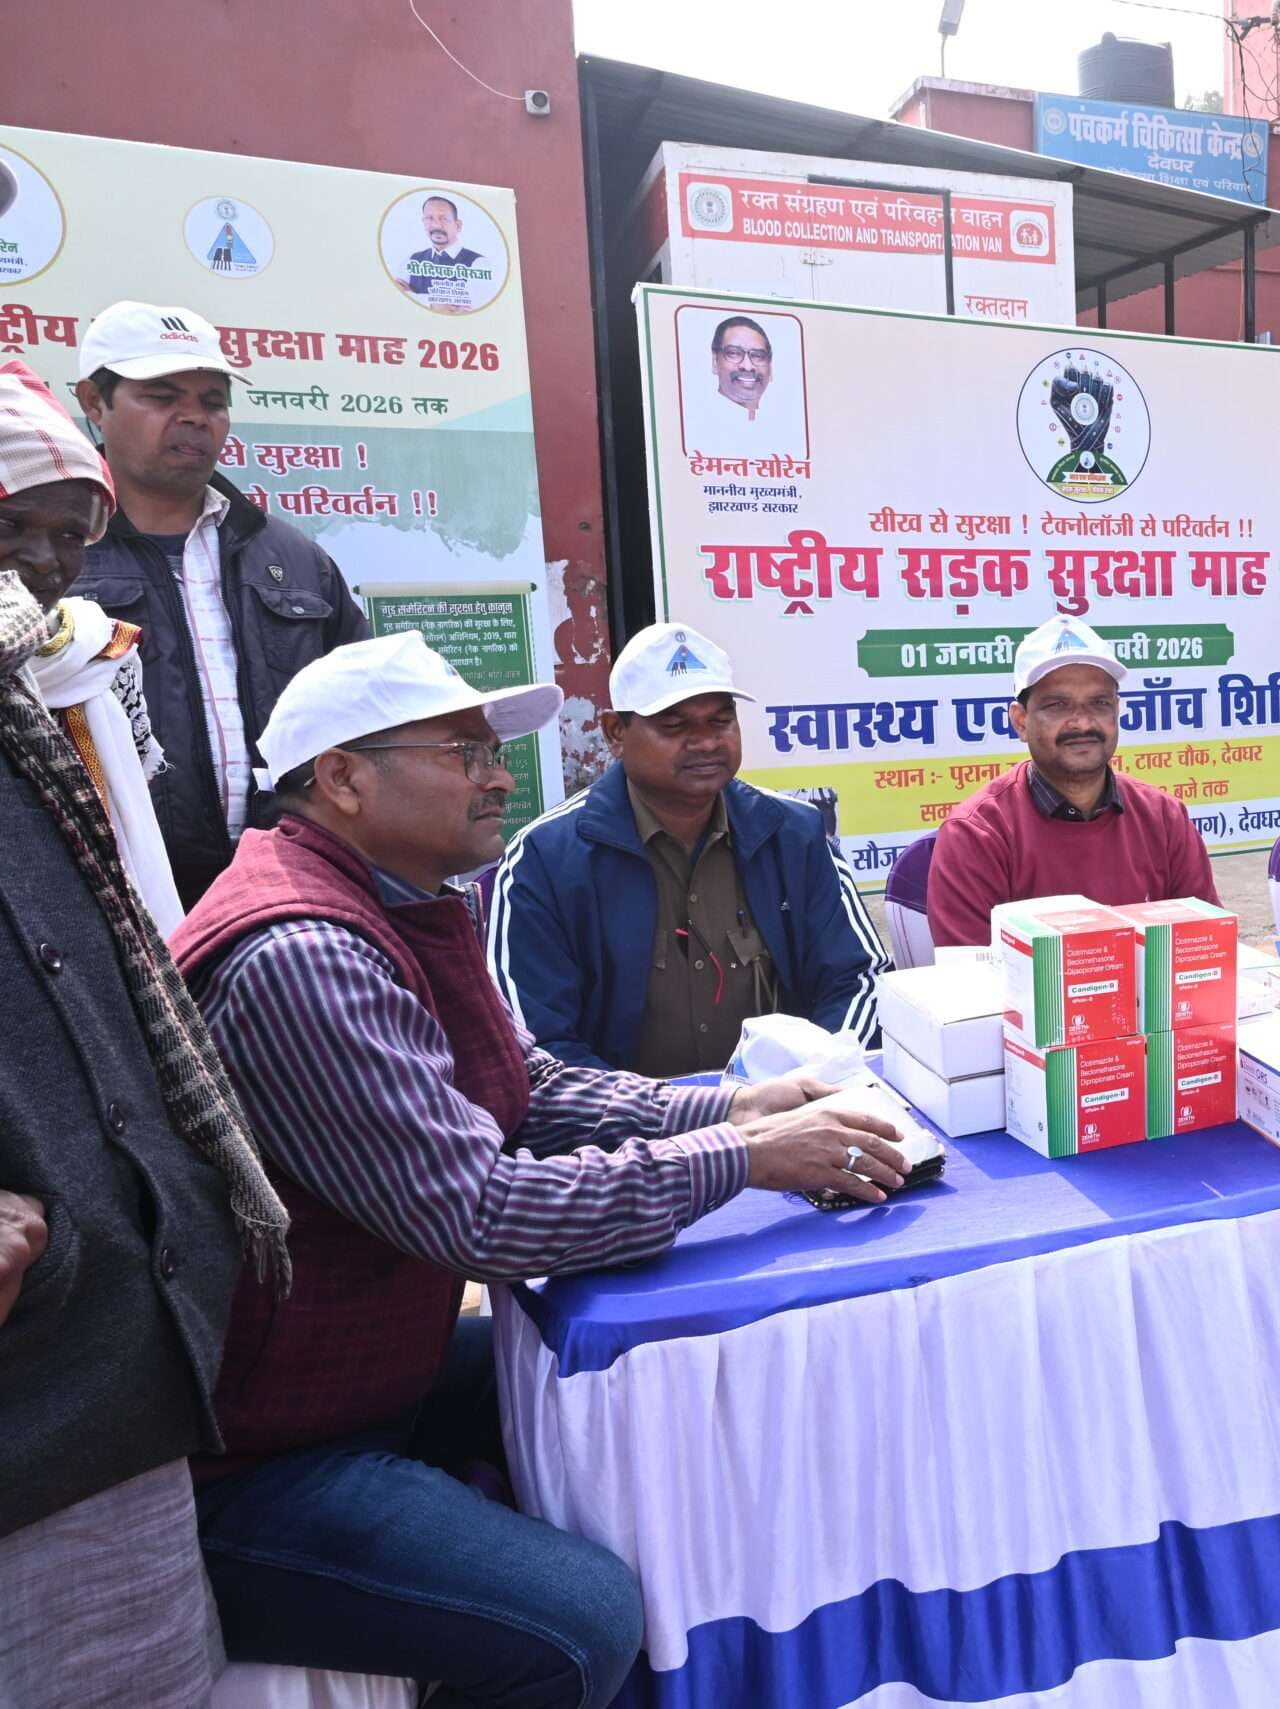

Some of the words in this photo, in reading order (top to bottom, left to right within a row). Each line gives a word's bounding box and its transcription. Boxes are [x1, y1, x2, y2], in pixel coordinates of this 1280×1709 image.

[1068, 104, 1128, 147] पंचकर्म
[1132, 112, 1203, 156] चिकित्सा
[1206, 121, 1244, 161] केन्द्र
[1147, 152, 1196, 174] देवघर
[740, 188, 779, 211] रक्त
[784, 188, 845, 219] संग्रहण
[849, 195, 879, 221] एवं
[961, 208, 1004, 230] वाहन
[743, 219, 782, 239] BLOOD
[784, 223, 854, 244] COLLECTION
[855, 228, 878, 245] AND
[982, 237, 1002, 253] VAN
[964, 294, 1029, 319] रक्तदान
[160, 331, 199, 343] adidas
[338, 333, 408, 364] माह
[417, 337, 500, 372] 2026
[247, 386, 330, 412] जनवरी
[341, 394, 403, 415] 2026
[413, 393, 449, 416] तक
[256, 440, 342, 476] सुरक्षा
[357, 442, 367, 468] !
[688, 450, 749, 477] हेमन्त
[756, 453, 812, 480] सोरेन
[279, 488, 398, 517] परिवर्तन
[413, 493, 438, 516] !!
[703, 484, 746, 498] माननीय
[762, 502, 799, 514] सरकार
[869, 507, 922, 535] सीख
[929, 508, 948, 534] से
[955, 514, 1012, 541] सुरक्षा
[1022, 514, 1028, 535] !
[1041, 510, 1134, 537] टेक्नोलॉजी
[1140, 513, 1157, 537] से
[1163, 514, 1231, 538] परिवर्तन
[1239, 518, 1253, 538] !!
[699, 529, 884, 616] राष्ट्रीय
[898, 547, 1031, 616] सड़क
[1046, 549, 1176, 616] सुरक्षा
[1189, 551, 1270, 597] माह
[901, 643, 928, 668] 01
[934, 635, 1014, 666] जनवरी
[1156, 636, 1204, 660] 2026
[765, 699, 939, 753] स्वास्थ्य
[1119, 677, 1207, 732] जाँच
[874, 767, 925, 790] स्थान
[950, 762, 1001, 789] पुराना
[1135, 751, 1173, 771] टावर
[1177, 744, 1216, 768] चौक,
[1221, 742, 1263, 764] देवघर
[1174, 777, 1198, 800] बजे
[1202, 779, 1230, 798] तक
[1116, 1071, 1135, 1080] Cream
